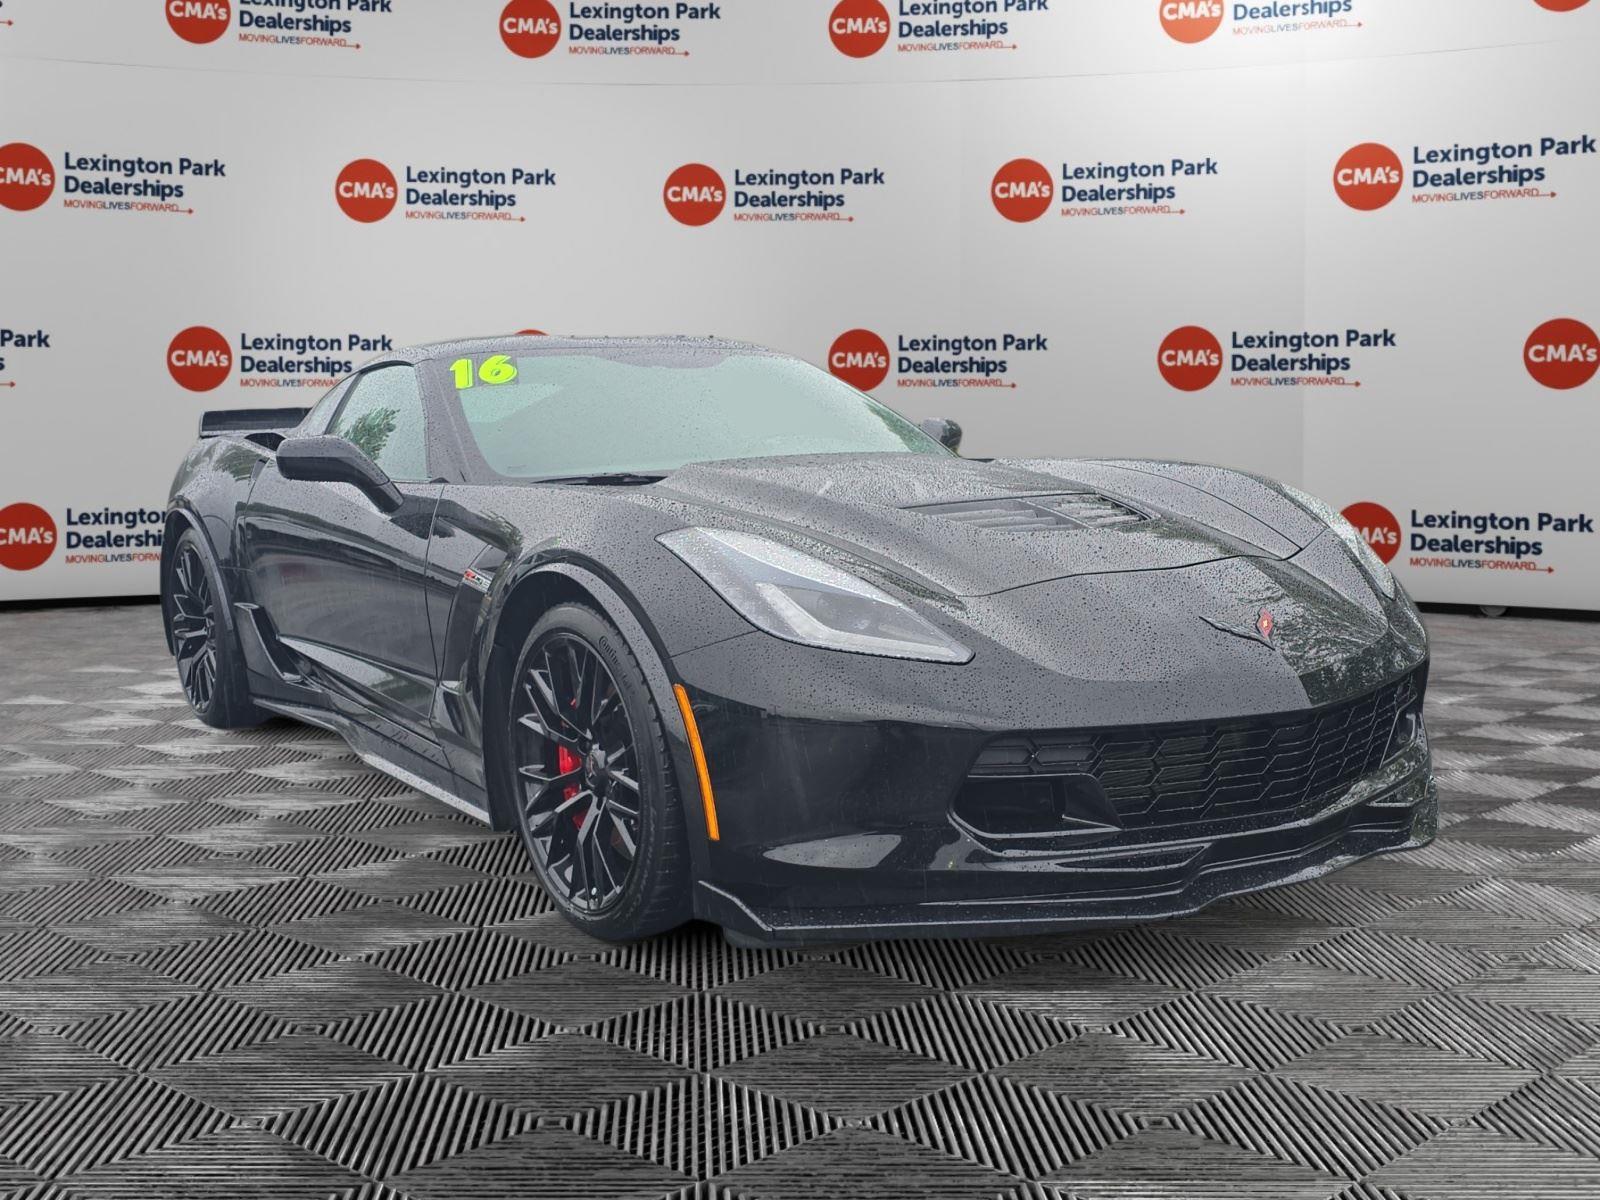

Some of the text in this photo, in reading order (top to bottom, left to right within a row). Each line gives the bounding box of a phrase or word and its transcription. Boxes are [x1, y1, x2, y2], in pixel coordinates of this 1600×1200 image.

[169, 1, 227, 20] CMA's
[570, 2, 720, 23] Lexington Park
[899, 0, 1048, 18] Lexington Park
[1162, 1, 1221, 20] CMA's
[1234, 0, 1352, 20] Dealerships
[240, 10, 351, 36] Dealerships
[504, 18, 557, 34] CMA's
[832, 18, 887, 34] CMA's
[899, 19, 1008, 39] Dealerships
[570, 24, 680, 45] Dealerships
[1414, 135, 1596, 165] Lexington Park
[65, 152, 225, 177] Lexington Park
[1063, 158, 1217, 182] Lexington Park
[407, 166, 555, 188] Lexington Park
[735, 168, 884, 189] Lexington Park
[1338, 167, 1399, 185] CMA's
[1413, 165, 1545, 187] Dealerships
[65, 176, 183, 201] Dealerships
[339, 182, 394, 198] CMA's
[667, 187, 722, 202] CMA's
[995, 182, 1050, 198] CMA's
[1062, 183, 1175, 203] Dealerships
[406, 188, 516, 210] Dealerships
[735, 191, 844, 211] Dealerships
[0, 329, 50, 347] Park
[241, 333, 392, 355] Lexington Park
[899, 334, 1047, 355] Lexington Park
[1232, 329, 1396, 352] Lexington Park
[172, 350, 228, 366] CMA's
[832, 352, 886, 367] CMA's
[1162, 350, 1219, 366] CMA's
[1529, 344, 1597, 362] CMA's
[241, 356, 352, 377] Dealerships
[450, 354, 517, 389] 16
[898, 357, 1007, 377] Dealerships
[1232, 354, 1350, 375] Dealerships
[240, 379, 339, 388] MOVINGLIVESFORWA
[1412, 510, 1593, 534] Lexington Park
[67, 530, 162, 549] Dealershi
[1354, 527, 1398, 545] MA's
[1411, 533, 1542, 559] Dealerships
[66, 553, 160, 563] MOVINGLIVESFORW
